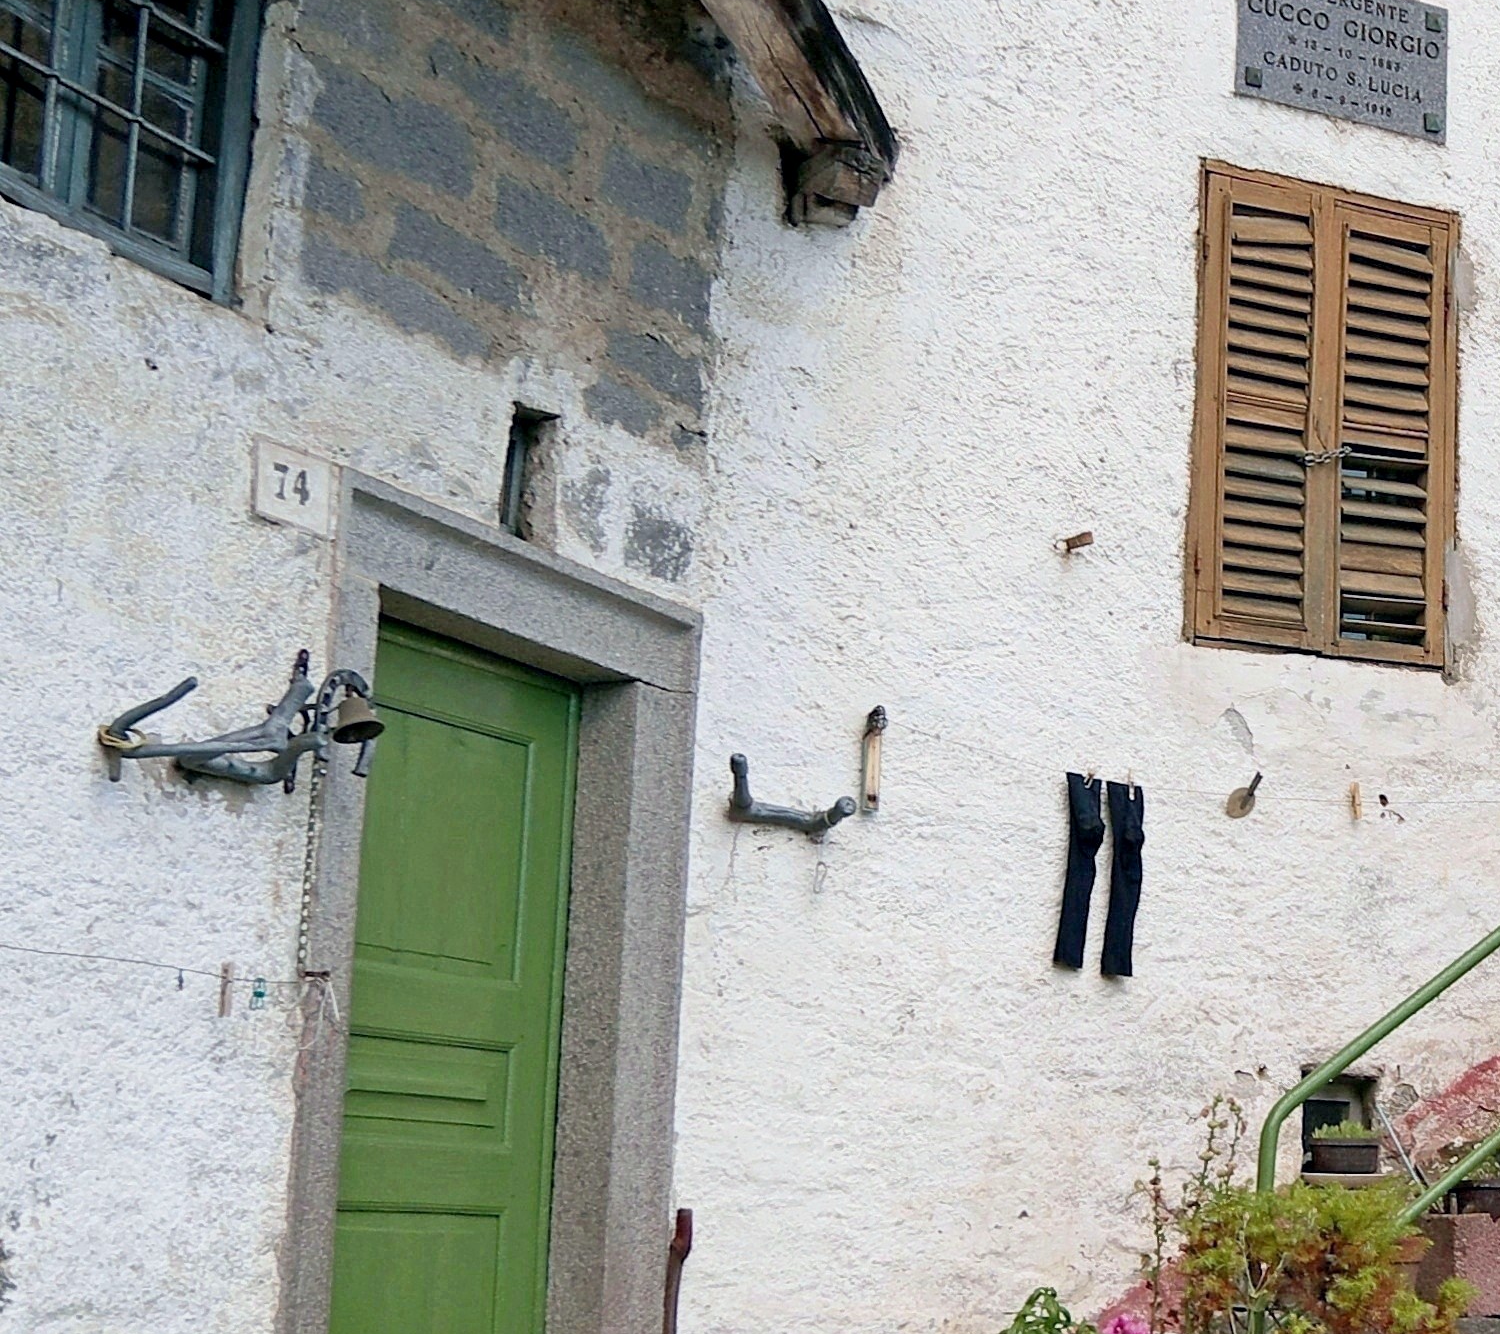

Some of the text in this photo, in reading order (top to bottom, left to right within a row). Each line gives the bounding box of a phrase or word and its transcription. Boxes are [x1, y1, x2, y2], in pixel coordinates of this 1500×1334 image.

[1338, 47, 1352, 60] 10
[1344, 19, 1440, 59] GIORGIO
[1263, 51, 1422, 104] CADUTO S. LUCIA
[273, 462, 310, 506] 74
